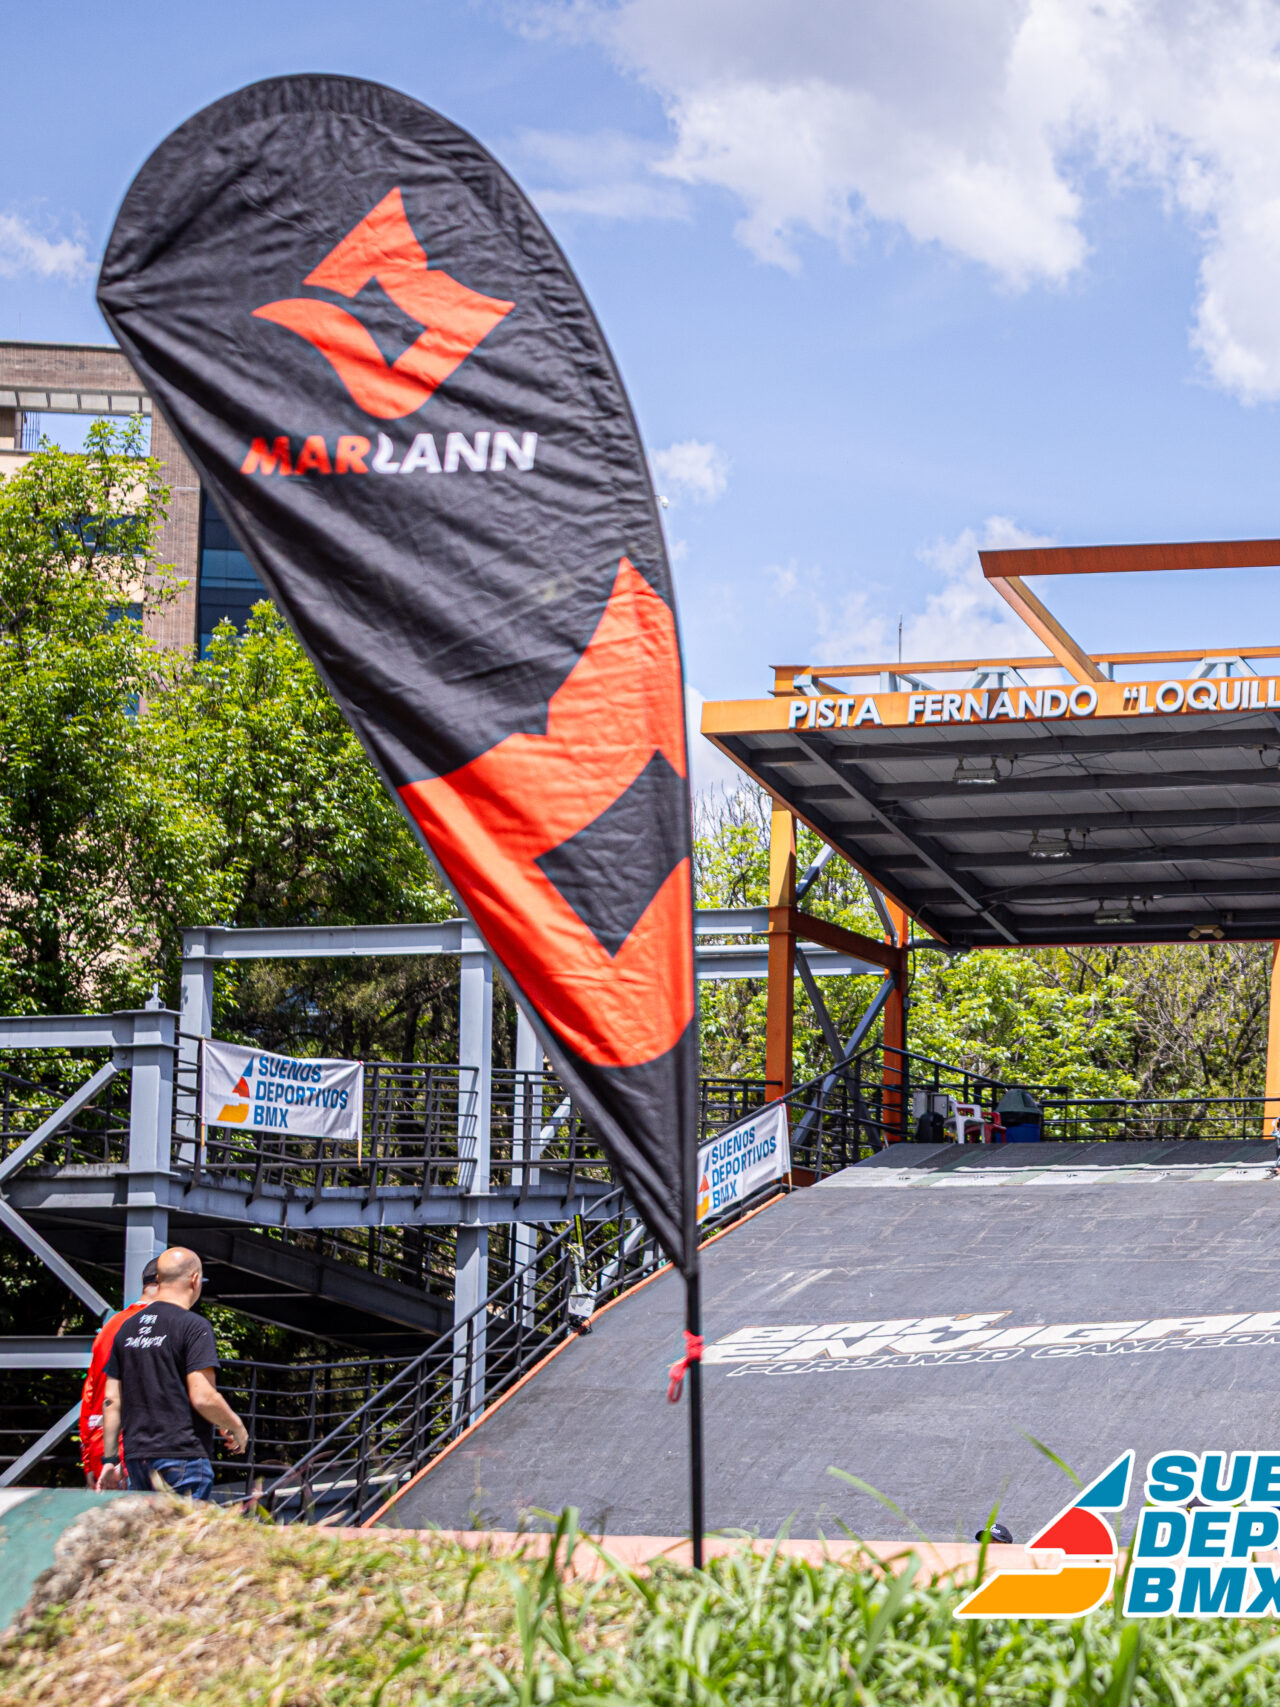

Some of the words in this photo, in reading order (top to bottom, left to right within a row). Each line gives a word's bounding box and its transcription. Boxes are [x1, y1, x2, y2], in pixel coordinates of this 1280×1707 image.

[240, 431, 539, 476] MARLANN
[788, 697, 883, 729] PISTA
[907, 684, 1098, 723] FERNANDO
[255, 1080, 349, 1111] DEPORTIVOS
[253, 1105, 290, 1129] BMX
[711, 1125, 756, 1166] SUEÑOS
[711, 1135, 778, 1188] DEPORTIVOS
[712, 1179, 738, 1209] BMX
[726, 1347, 1026, 1377] FORJANDO
